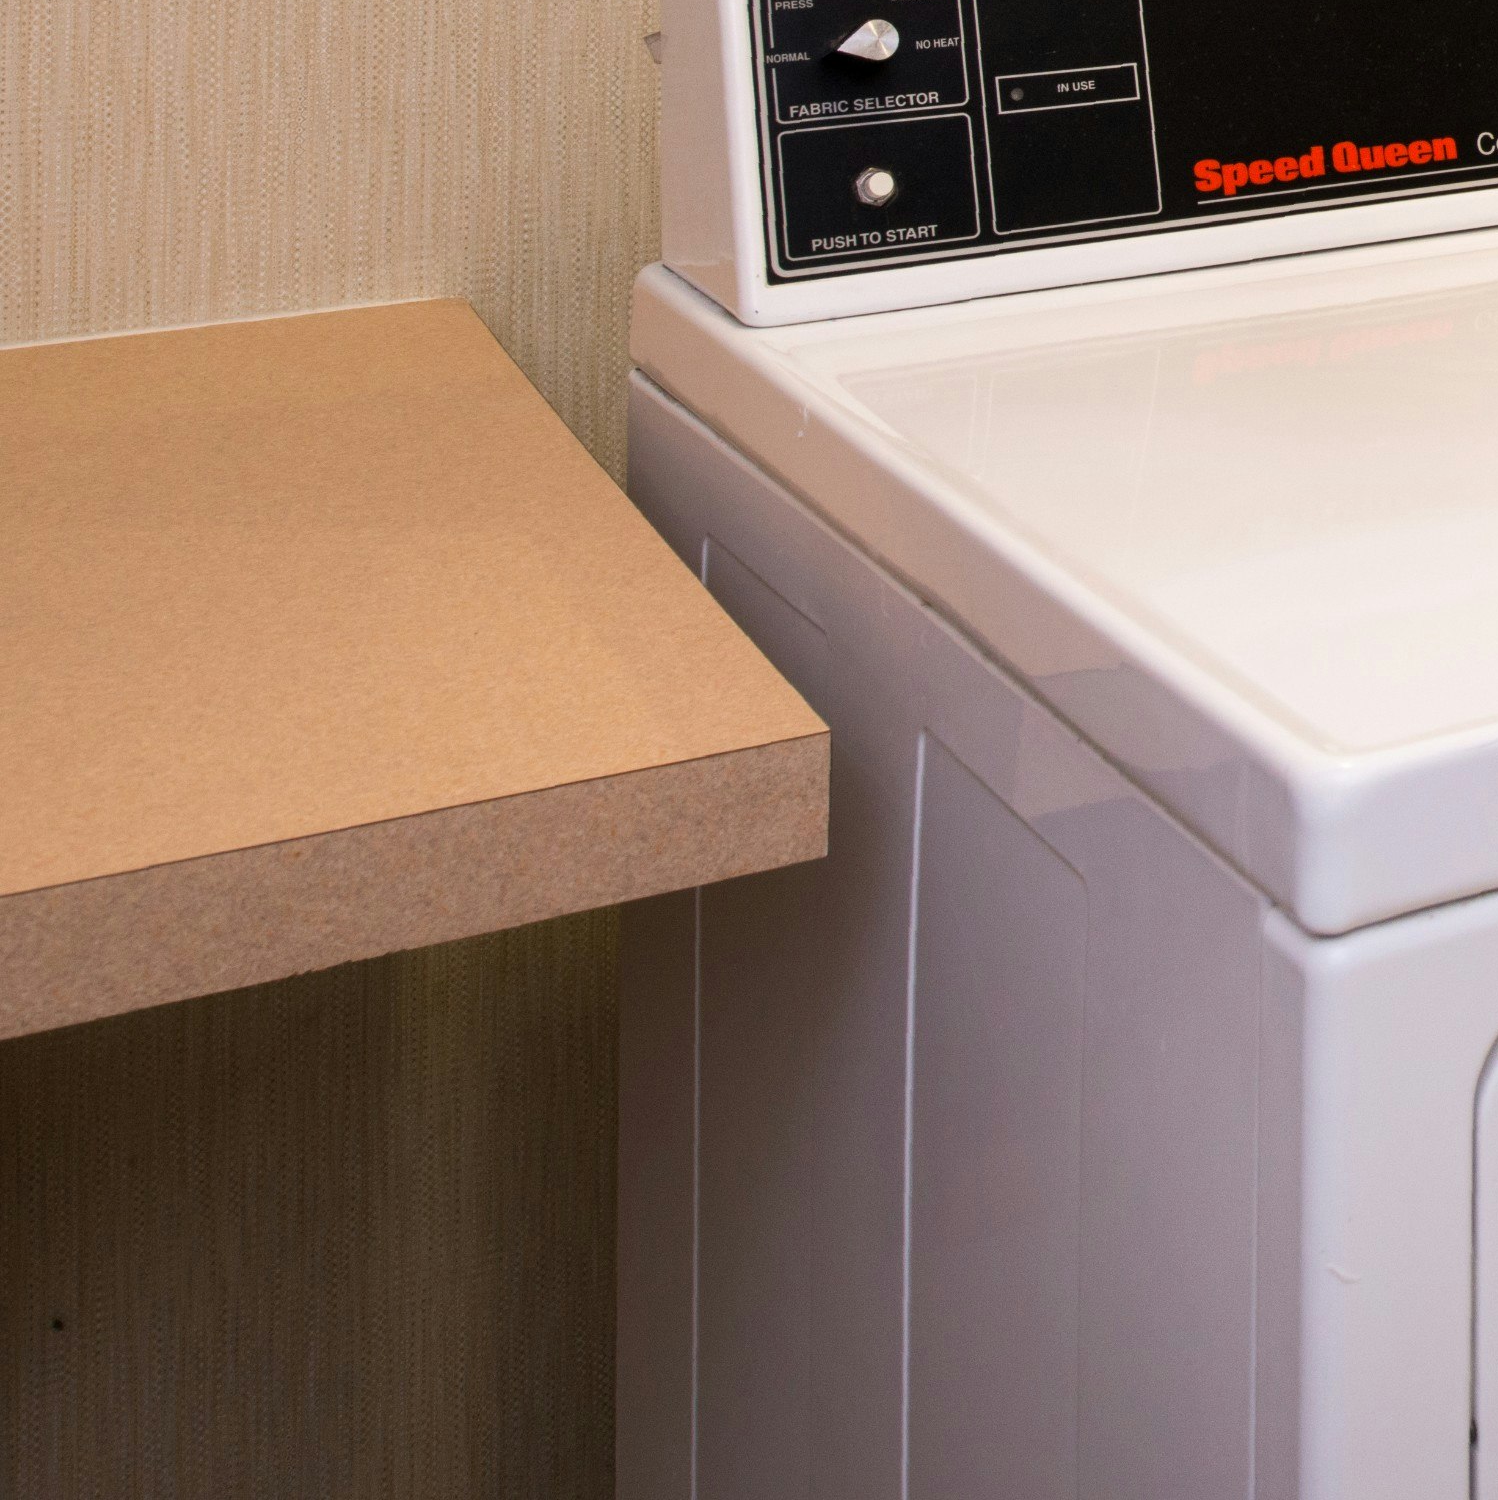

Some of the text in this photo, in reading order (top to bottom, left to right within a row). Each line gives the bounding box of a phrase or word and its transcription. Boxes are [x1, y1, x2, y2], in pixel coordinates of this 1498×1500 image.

[774, 0, 814, 11] PRESS
[915, 37, 960, 50] NO HEAT
[766, 52, 811, 64] NORMAL
[1057, 80, 1096, 93] IN USE
[789, 91, 939, 118] FABRIC SELECTOR
[1193, 145, 1326, 196] Speed
[1331, 136, 1458, 173] Queen
[811, 224, 938, 252] PUSH TO START
